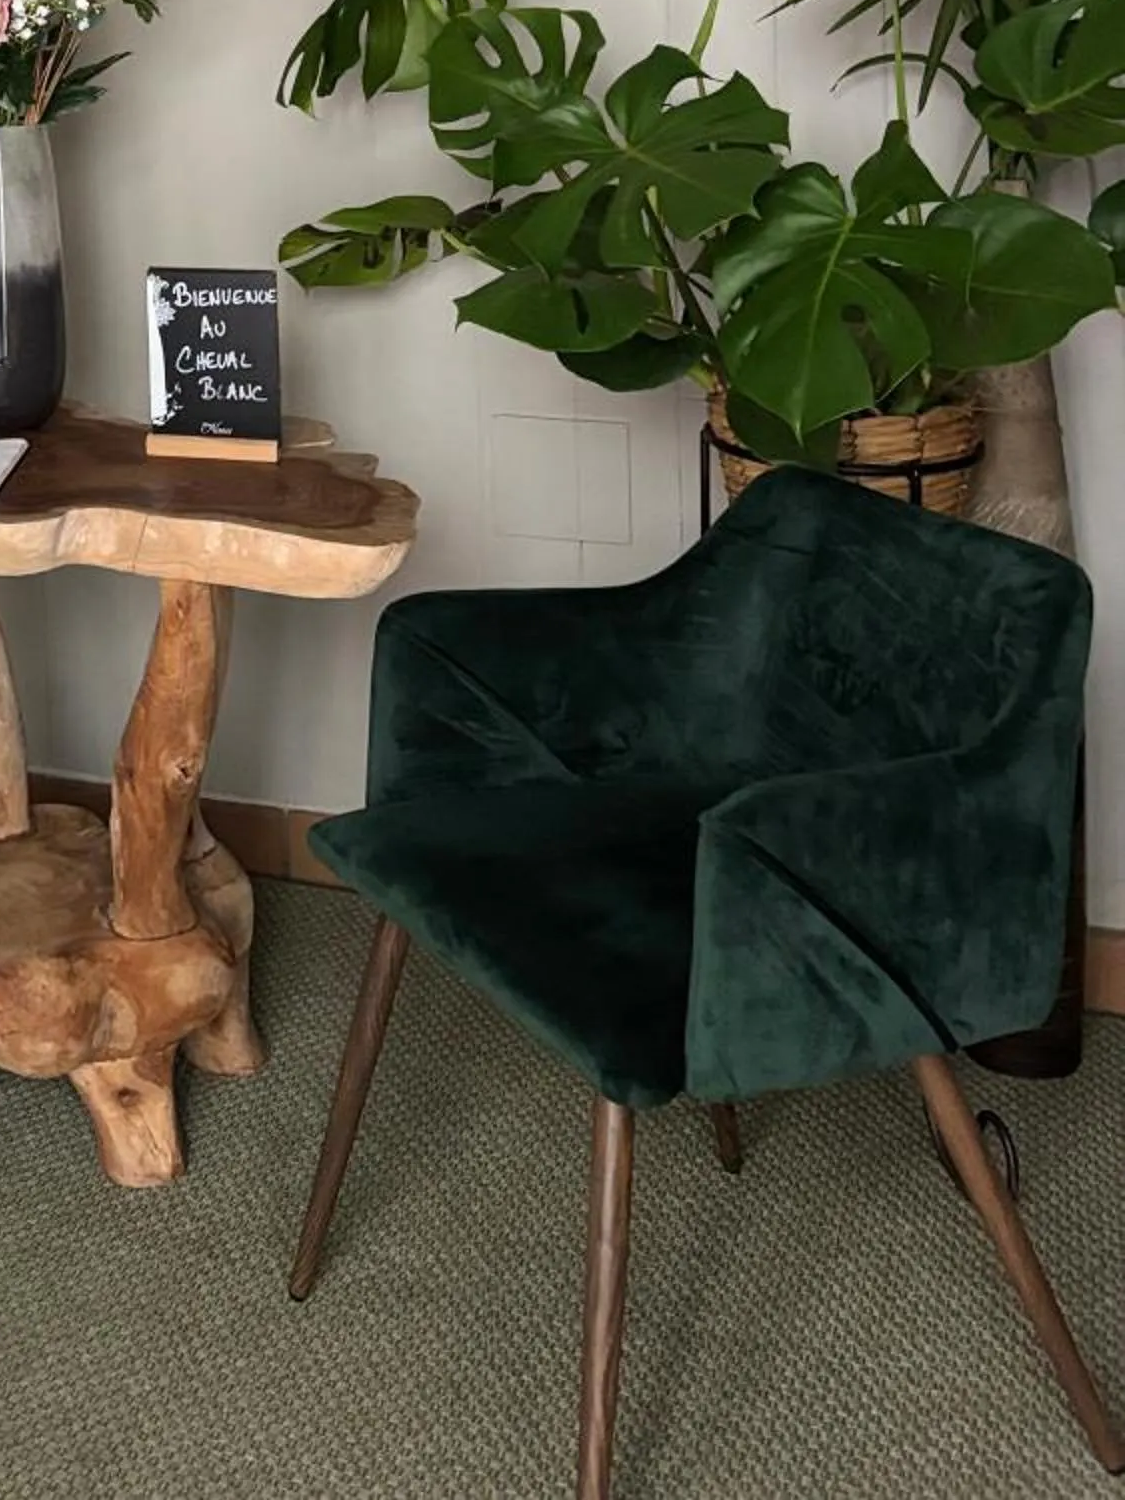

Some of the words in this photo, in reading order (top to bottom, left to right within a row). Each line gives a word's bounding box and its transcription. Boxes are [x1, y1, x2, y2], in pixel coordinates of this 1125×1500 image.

[172, 281, 277, 308] BIENVENUE
[200, 315, 226, 340] AU
[176, 345, 252, 374] CHEVAL
[199, 375, 267, 402] BLANC
